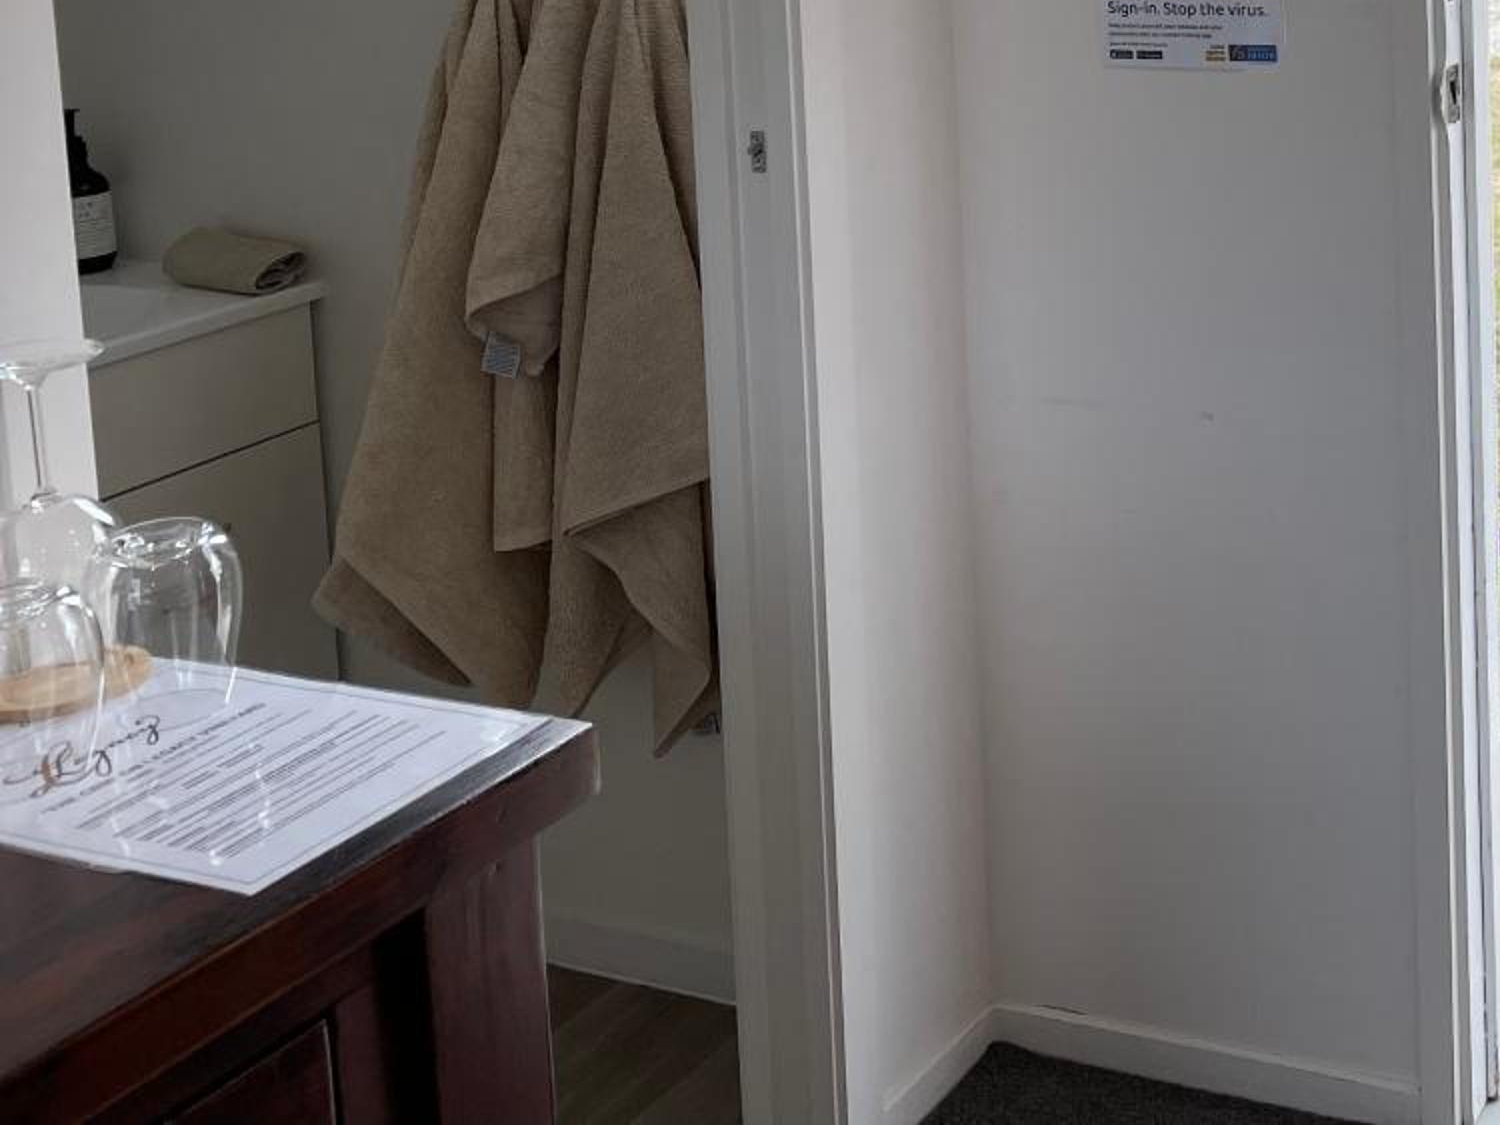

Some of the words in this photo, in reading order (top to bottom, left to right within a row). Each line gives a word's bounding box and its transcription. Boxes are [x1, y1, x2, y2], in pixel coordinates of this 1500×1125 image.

[1107, 0, 1160, 17] Sign-in.
[1163, 2, 1197, 18] Stop
[1200, 2, 1225, 16] the
[1228, 2, 1269, 17] virus.
